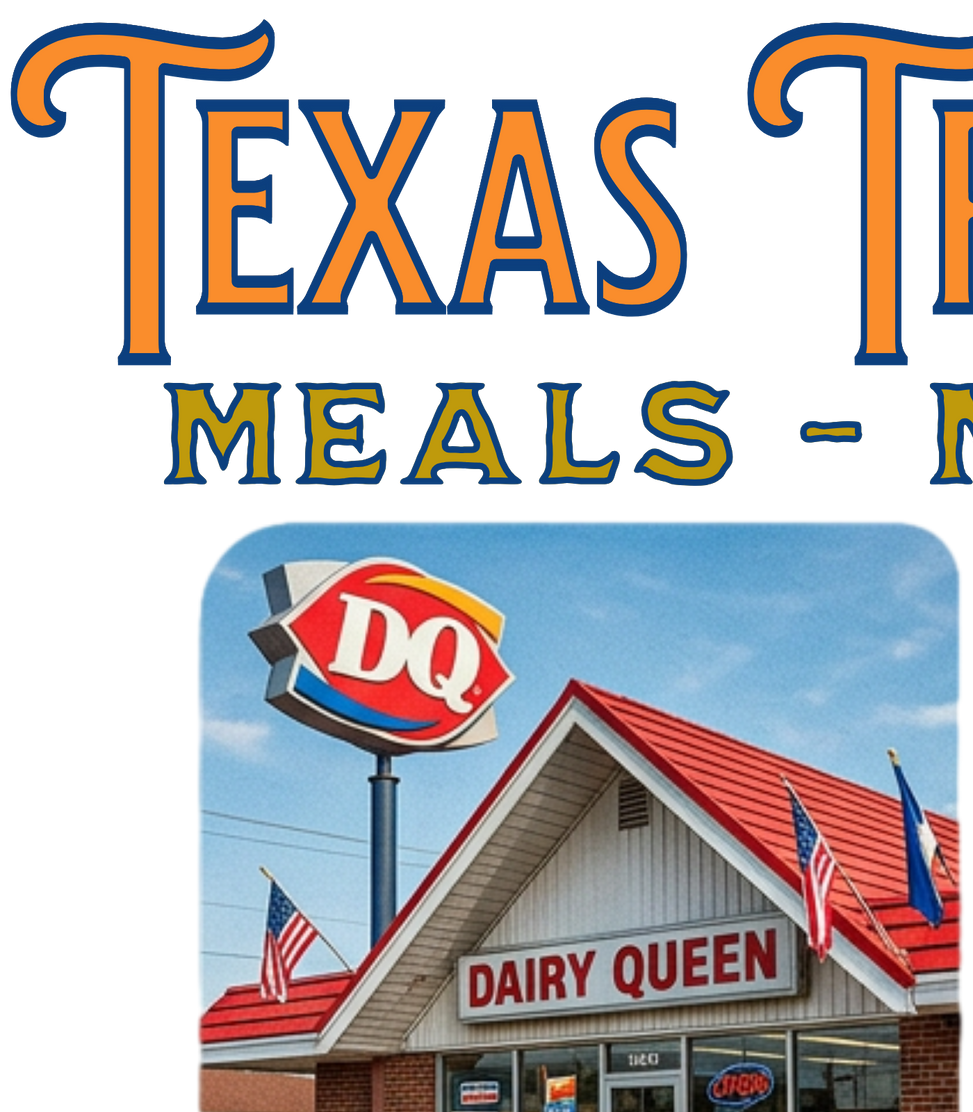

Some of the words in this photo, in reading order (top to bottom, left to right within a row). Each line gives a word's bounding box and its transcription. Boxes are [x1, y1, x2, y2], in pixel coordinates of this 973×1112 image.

[328, 592, 482, 714] DQ
[469, 951, 596, 1007] DAIRY
[613, 928, 777, 999] QUEEN
